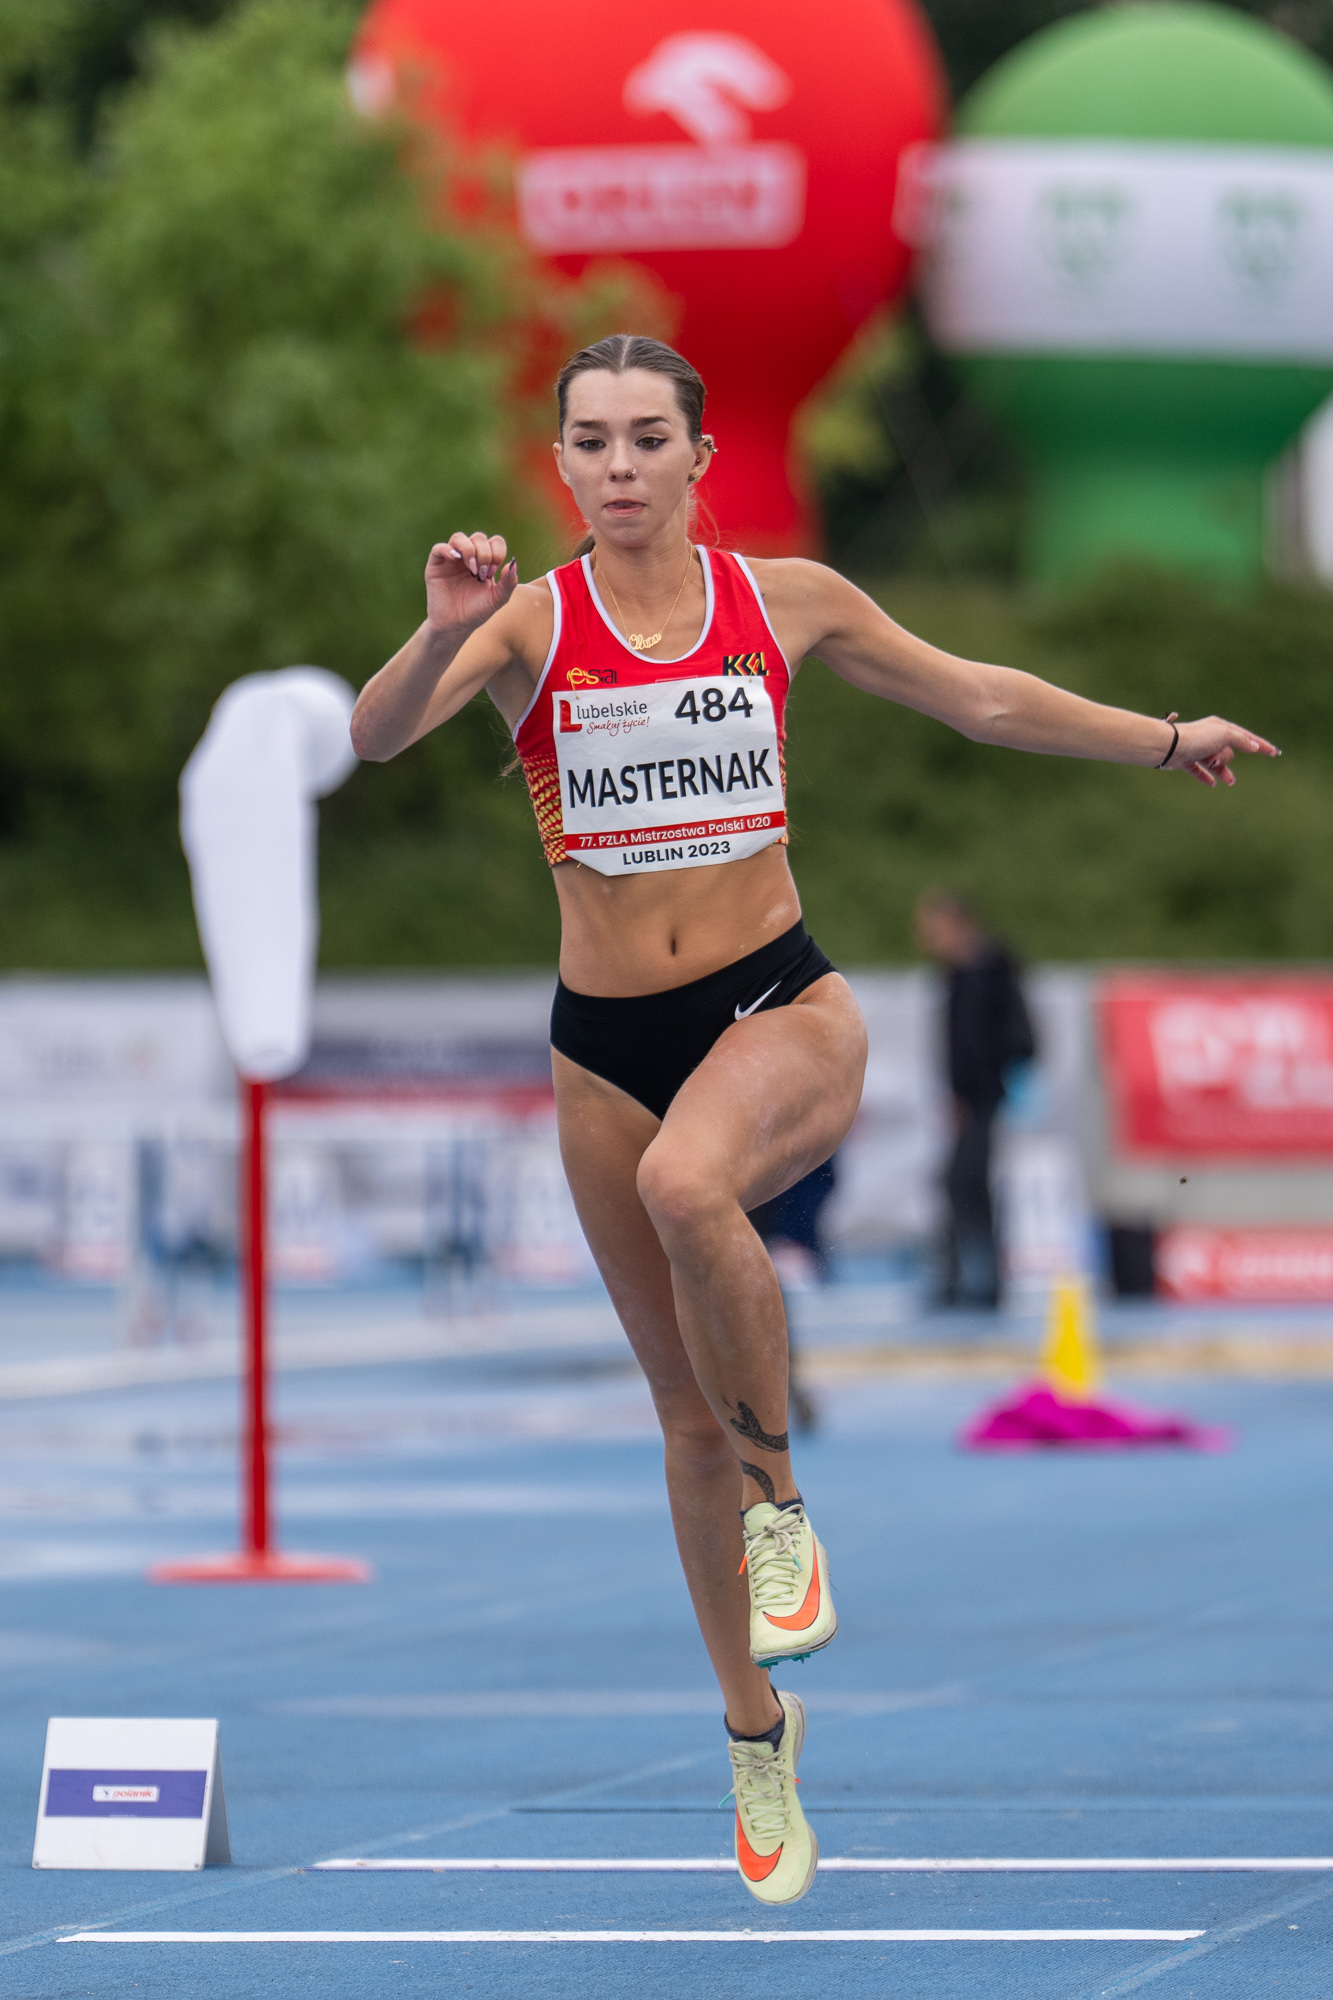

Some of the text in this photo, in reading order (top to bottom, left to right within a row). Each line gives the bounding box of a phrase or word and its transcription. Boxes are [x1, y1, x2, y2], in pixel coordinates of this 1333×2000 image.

[674, 686, 753, 725] 484
[586, 716, 650, 737] Smakuj życie!
[567, 748, 774, 809] MASTERNAK
[579, 816, 771, 848] 77. PZLA Mistrzostwa Polski U20
[622, 840, 731, 866] LUBLIN 2023
[112, 1789, 152, 1799] polanik
